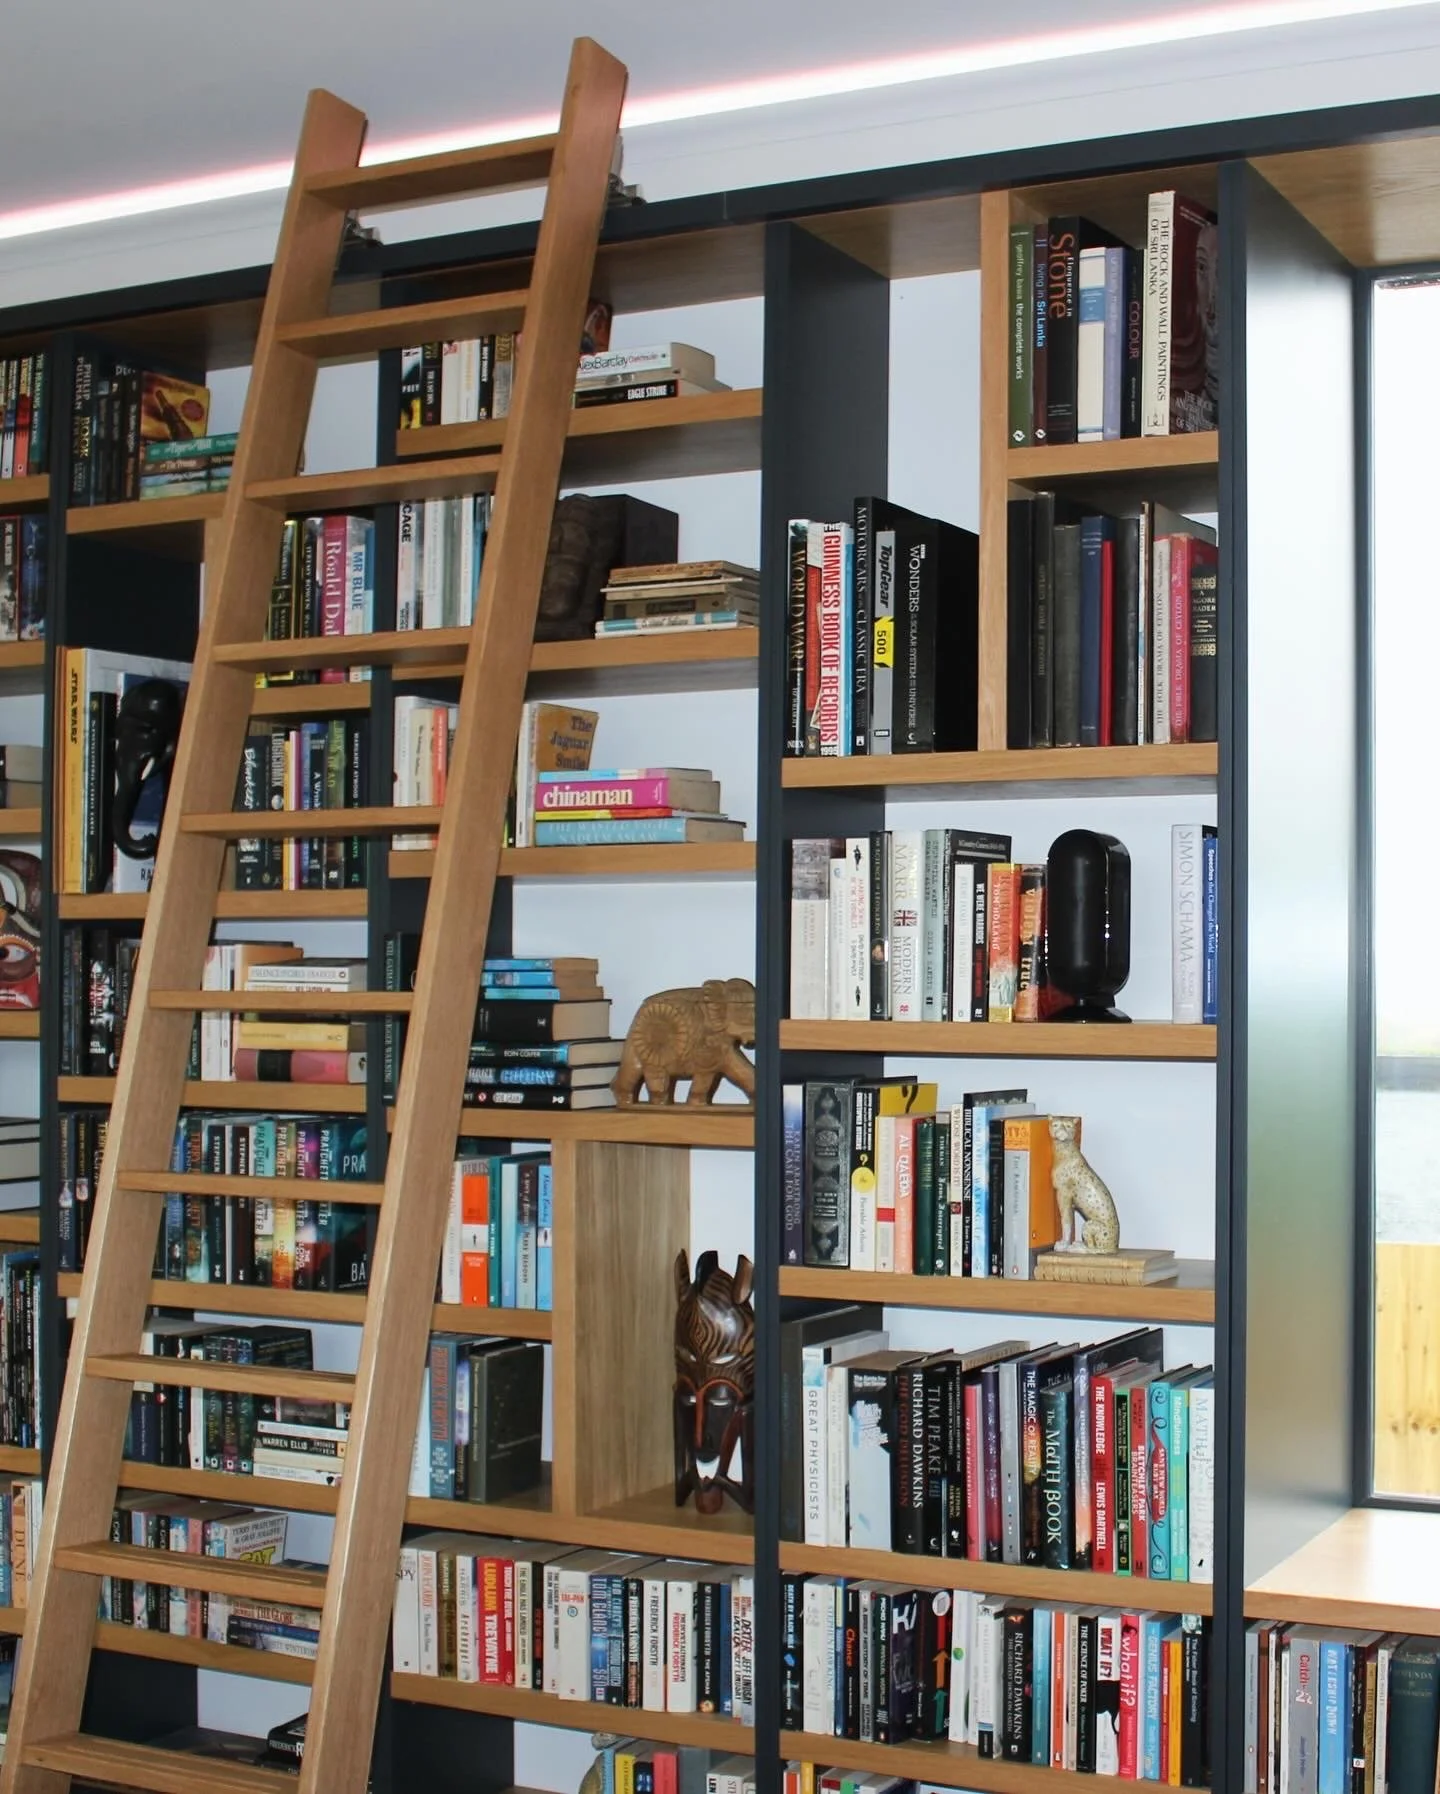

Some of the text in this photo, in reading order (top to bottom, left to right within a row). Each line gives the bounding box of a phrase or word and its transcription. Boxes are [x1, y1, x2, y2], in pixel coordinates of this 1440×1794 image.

[1015, 244, 1025, 276] geoffrey
[1048, 232, 1074, 319] Stone
[1148, 219, 1159, 296] OF SRI LANKA
[1015, 303, 1024, 316] the
[1035, 263, 1045, 347] living in Sri Lanka
[1066, 257, 1074, 317] Eloquence in
[1156, 219, 1170, 401] THE ROCK AND WALL PAINTINGS
[1014, 318, 1024, 354] complete
[1128, 301, 1140, 359] COLOUR
[74, 357, 83, 410] PULLMAN
[83, 364, 91, 400] PHILIP
[628, 387, 645, 400] EAGLE
[1015, 356, 1023, 379] works
[401, 504, 412, 543] CAGE
[304, 579, 312, 610] BOWEN
[352, 552, 363, 610] MR BLUE
[855, 507, 867, 693] MOTORCARS CLASSIC ERA
[878, 544, 892, 608] TopGear
[820, 535, 840, 742] GUINNESS BOOK OF RECORDS
[876, 630, 887, 655] 500
[908, 545, 920, 728] WONDERS SOLAR SYSTEM UNIVERSE
[70, 668, 78, 745] STAR WARS
[571, 716, 593, 732] The
[271, 733, 284, 787] LOGICOMIX
[549, 731, 590, 750] Jaguar
[244, 748, 258, 810] Blankets
[543, 785, 633, 808] chinaman
[894, 844, 908, 901] MARR
[1178, 831, 1194, 962] SIMON SCHAMA
[975, 884, 984, 944] WE WERE WARRIORS
[992, 883, 1001, 949] TOM HOLLAND
[892, 936, 902, 994] BRITAIN
[902, 936, 912, 994] MODERN
[785, 1123, 793, 1230] THE CASE FOR GOD
[896, 1134, 911, 1198] AL QAEDA
[262, 1437, 308, 1451] WARREN ELLIS
[912, 1373, 923, 1508] RICHARD DAWKINS
[927, 1386, 941, 1474] TIM PEAKE
[1047, 1409, 1056, 1425] The
[1172, 1396, 1181, 1455] Mindfulness
[808, 1390, 819, 1520] GREAT PHYSICISTS
[1095, 1386, 1106, 1551] THE KNOWLEDGE LEWIS DARTNELL
[1137, 1445, 1145, 1496] BLETCHLEY
[15, 1529, 25, 1582] DUNE
[395, 1568, 416, 1583] SPY
[484, 1562, 498, 1673] LUDLUM TREVAYNE
[592, 1578, 608, 1687] TOM CLANCY SSN
[629, 1596, 638, 1632] FREDERICK
[650, 1596, 658, 1666] FREDERICK FORSYTH
[787, 1602, 794, 1612] BY
[1080, 1625, 1088, 1640] THE
[459, 1614, 470, 1664] Archangel
[672, 1613, 680, 1682] FREDERICK FORSYTH
[741, 1619, 752, 1705] DEXTER JEFF LINDSAY
[846, 1628, 855, 1667] Chance
[1080, 1641, 1088, 1668] SCIENCE
[1099, 1627, 1112, 1678] WHAT IF?
[863, 1669, 868, 1679] OF
[1013, 1632, 1023, 1740] RICHARD DAWKINS
[1080, 1670, 1088, 1678] OF
[1119, 1636, 1136, 1707] what if?
[1147, 1635, 1157, 1720] GENIUS FACTORY
